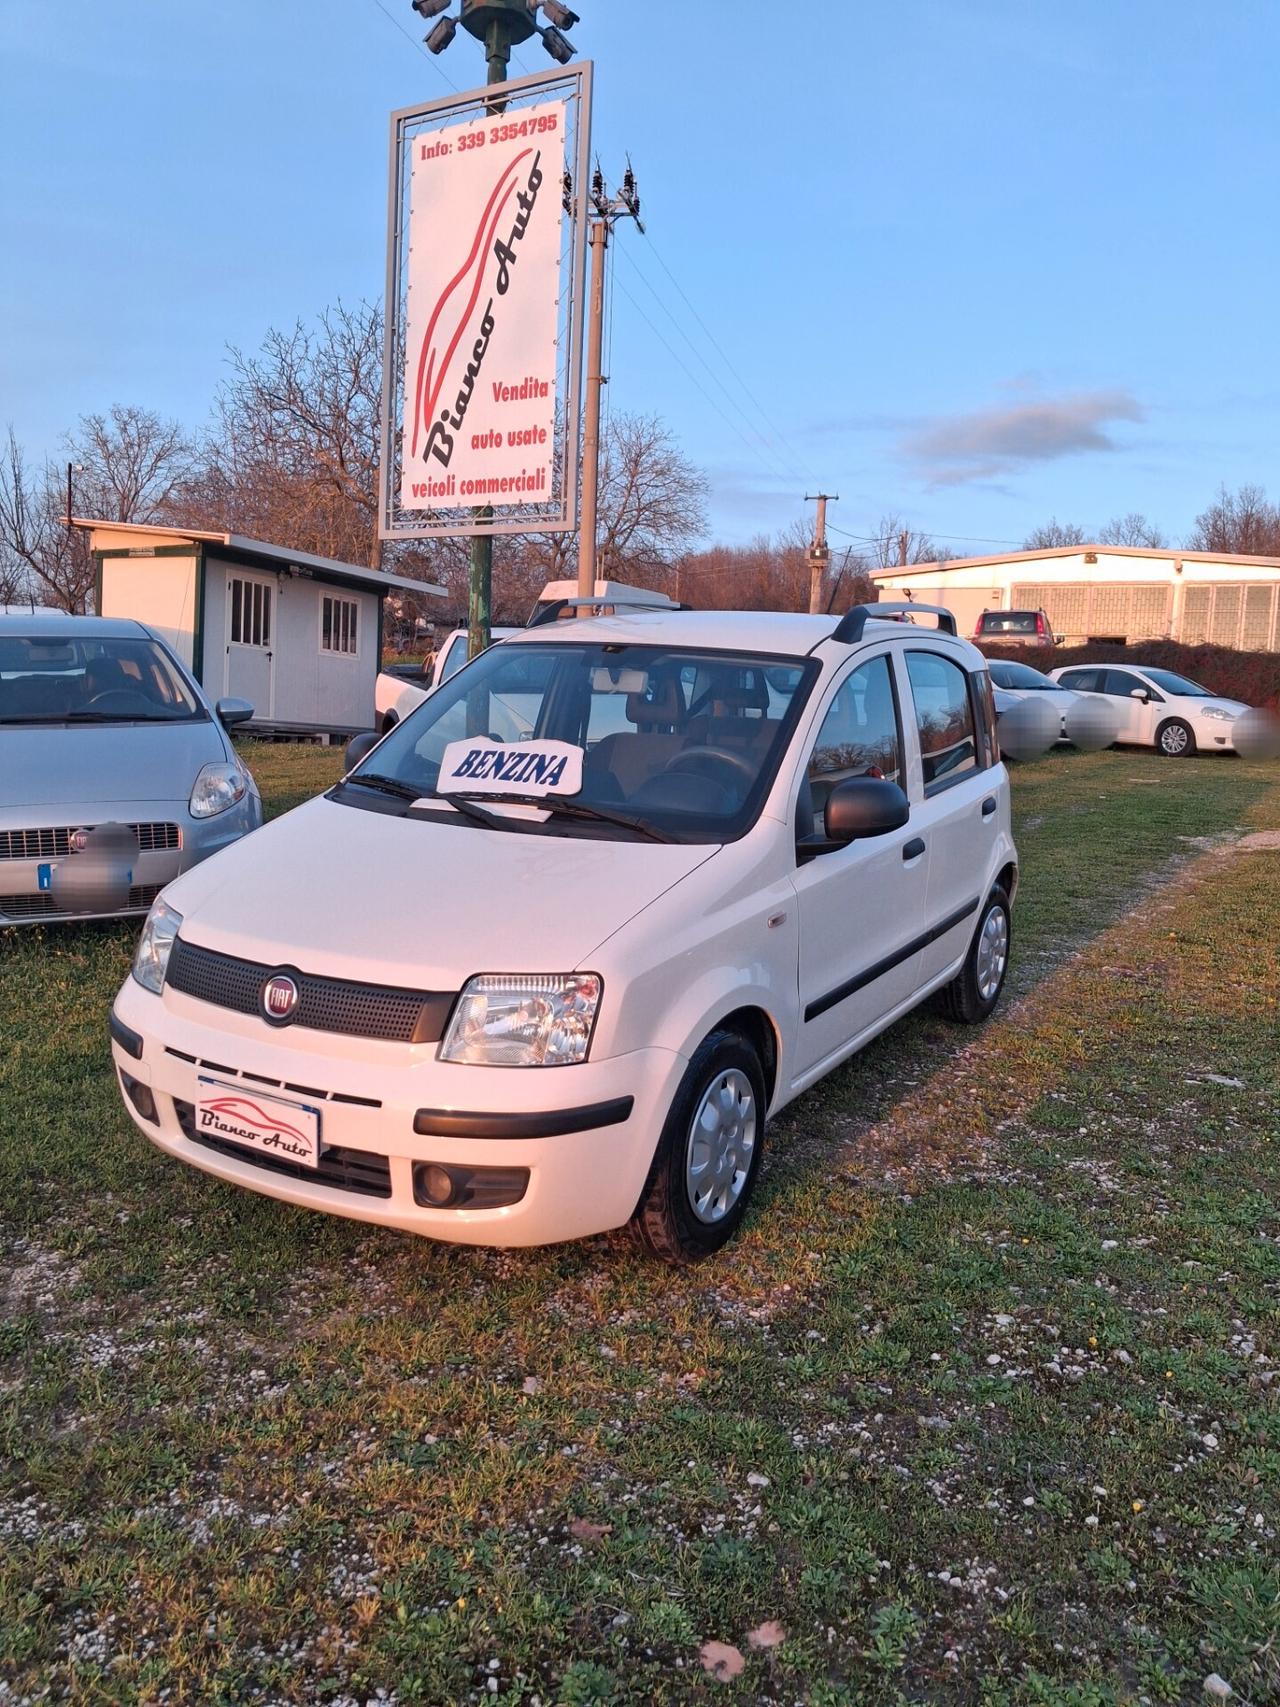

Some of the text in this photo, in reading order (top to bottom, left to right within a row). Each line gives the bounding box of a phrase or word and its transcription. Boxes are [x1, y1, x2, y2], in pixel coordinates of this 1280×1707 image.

[421, 114, 558, 160] Info: 339 3354795
[422, 150, 543, 468] Bianco Auto
[492, 376, 549, 402] Vendita
[471, 425, 547, 450] auto usate
[412, 467, 546, 498] veicoli commerciali
[451, 749, 568, 786] BENZINA
[270, 987, 291, 1008] FIAT
[200, 1108, 312, 1157] Bianco Auto
